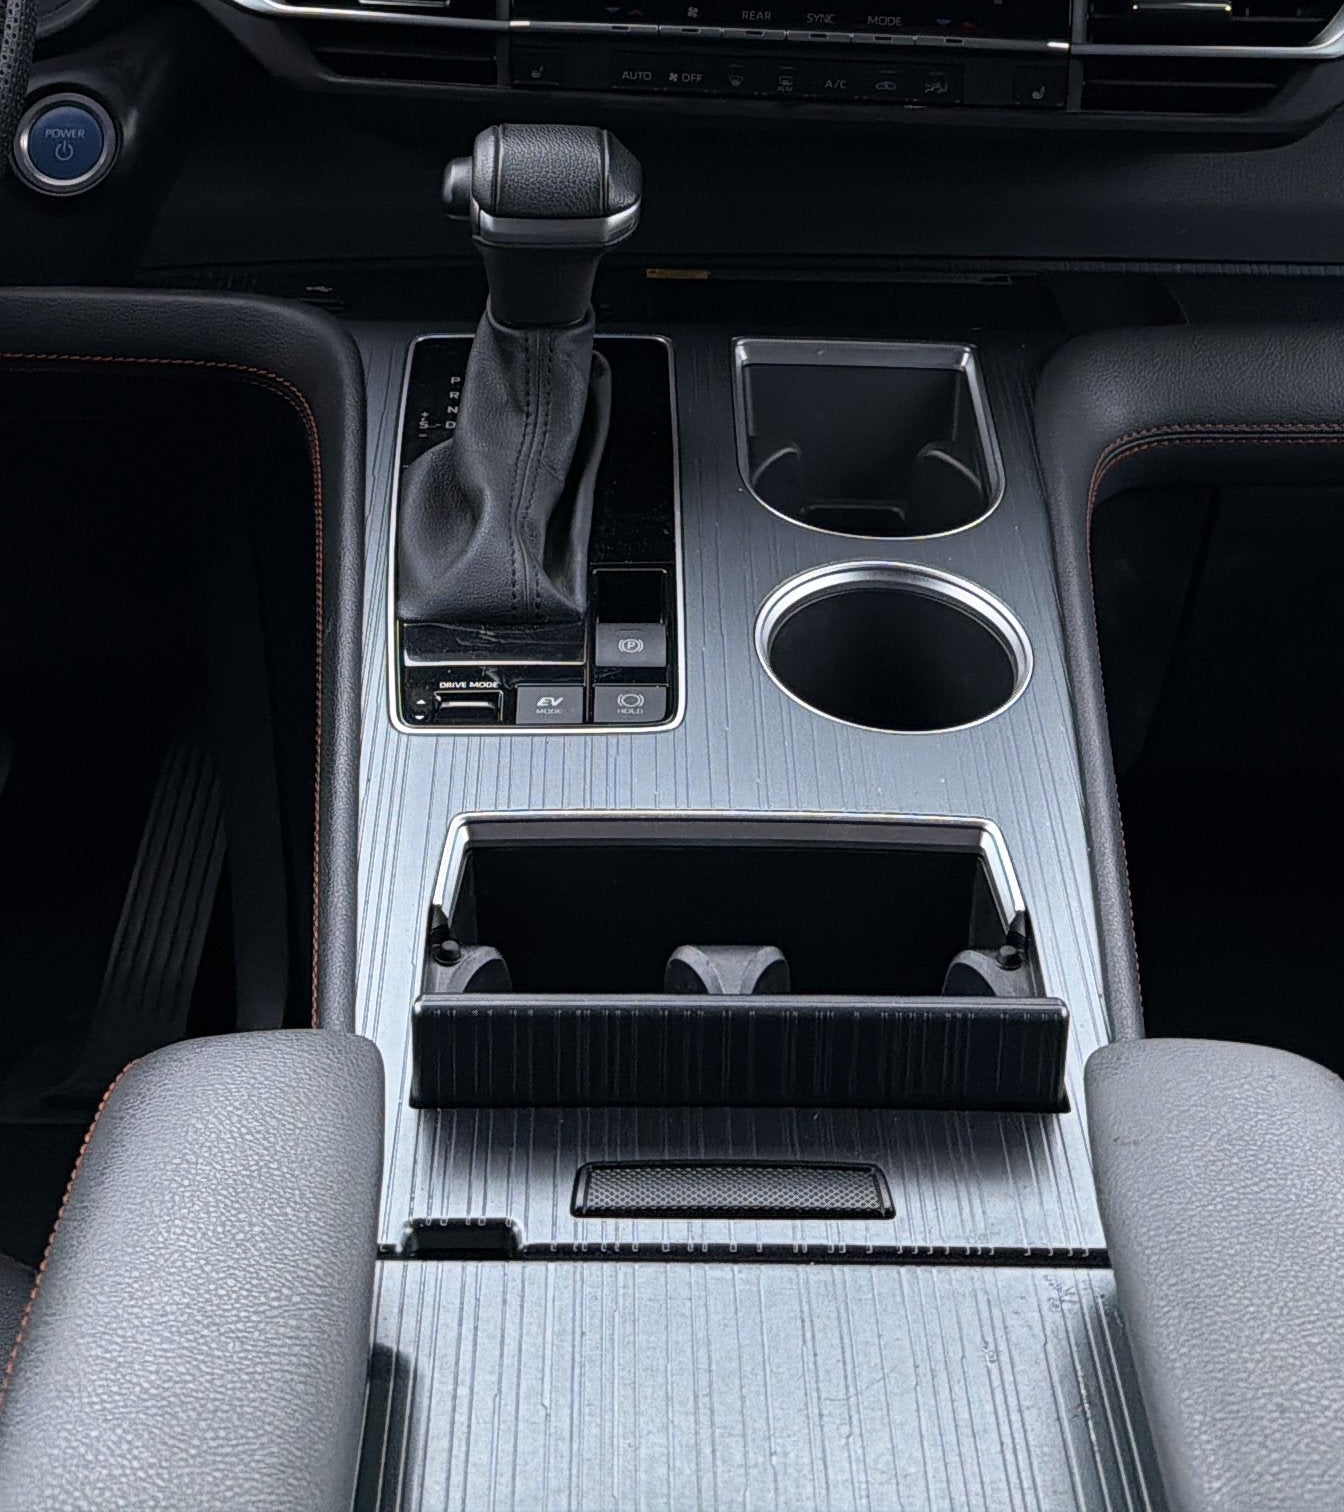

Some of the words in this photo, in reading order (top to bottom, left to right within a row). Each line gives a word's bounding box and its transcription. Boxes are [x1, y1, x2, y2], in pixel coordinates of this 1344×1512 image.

[741, 10, 773, 22] REAR
[806, 12, 836, 25] SYNC
[867, 15, 904, 28] MODE
[621, 70, 653, 82] AUTO
[681, 72, 704, 84] OFF
[825, 79, 847, 89] A/C
[45, 128, 86, 138] POWER
[450, 376, 461, 385] P
[449, 391, 460, 399] R
[447, 405, 459, 414] N
[445, 420, 457, 429] D
[439, 681, 467, 689] DRIVE
[469, 681, 499, 689] MODE
[536, 696, 565, 707] EV
[616, 707, 644, 715] HOLD
